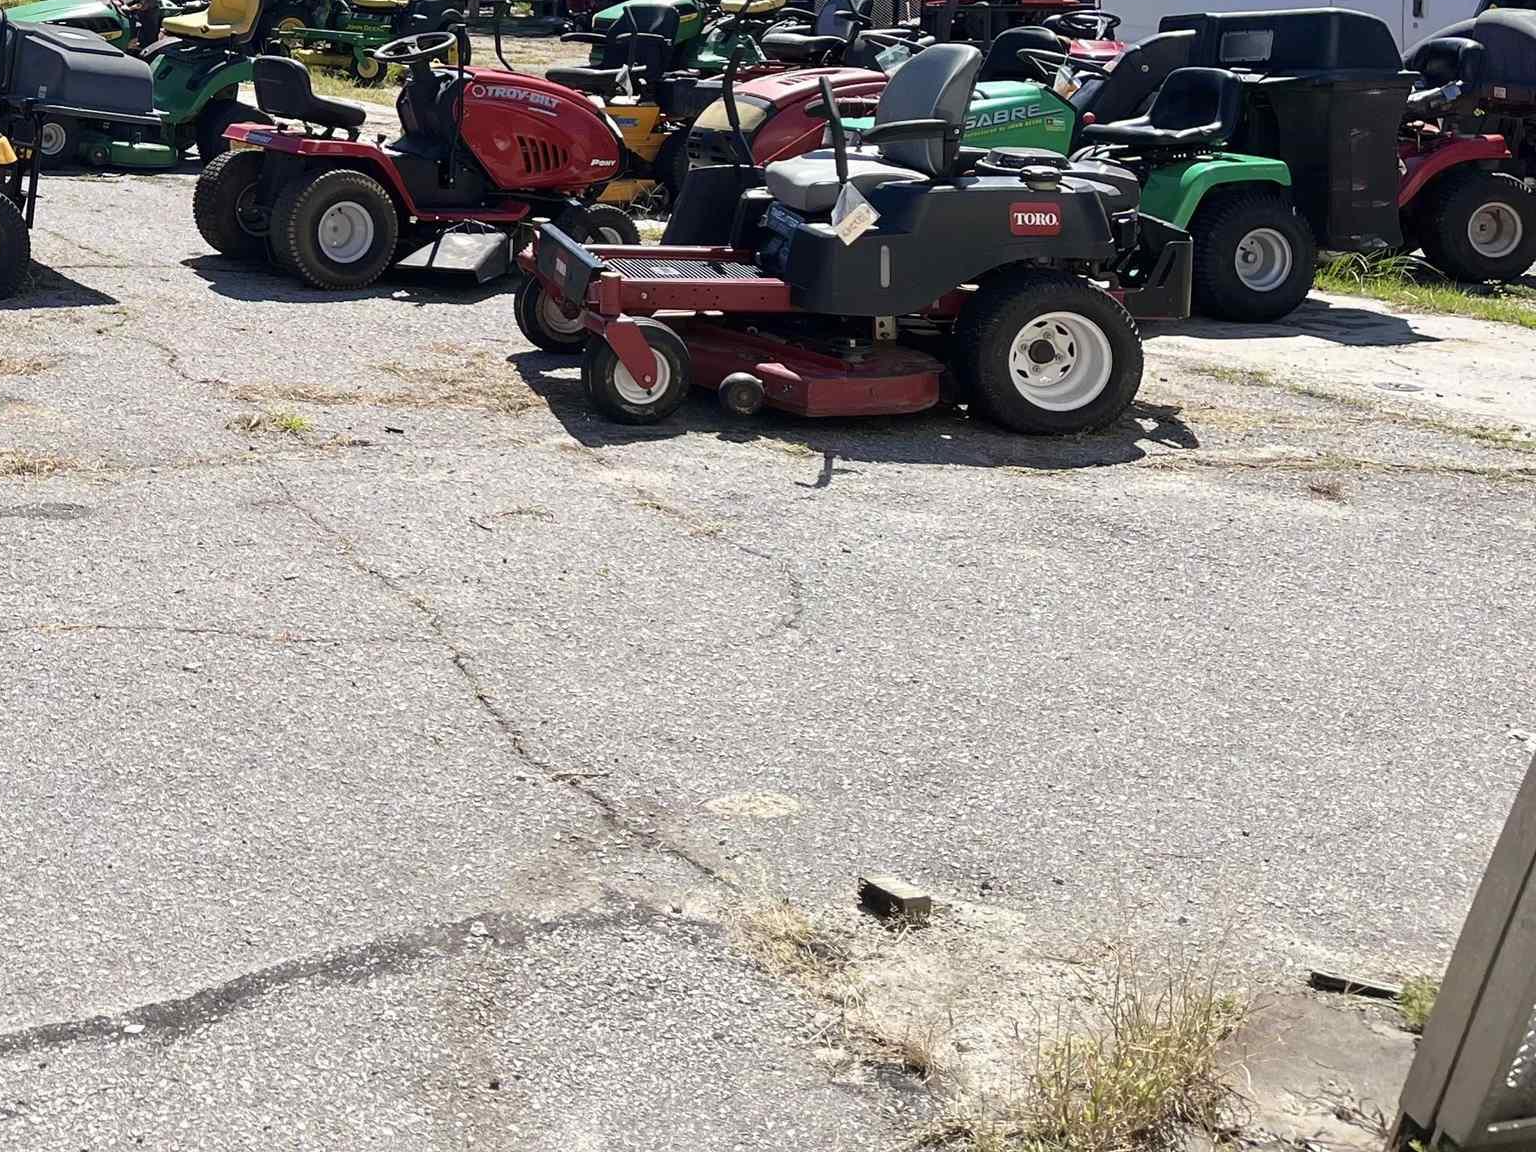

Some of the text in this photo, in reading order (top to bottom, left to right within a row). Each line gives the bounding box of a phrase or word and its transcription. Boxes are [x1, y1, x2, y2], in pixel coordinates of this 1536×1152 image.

[486, 85, 561, 108] TROY-BILT
[965, 104, 1041, 130] SABRE
[1013, 212, 1058, 226] TORO
